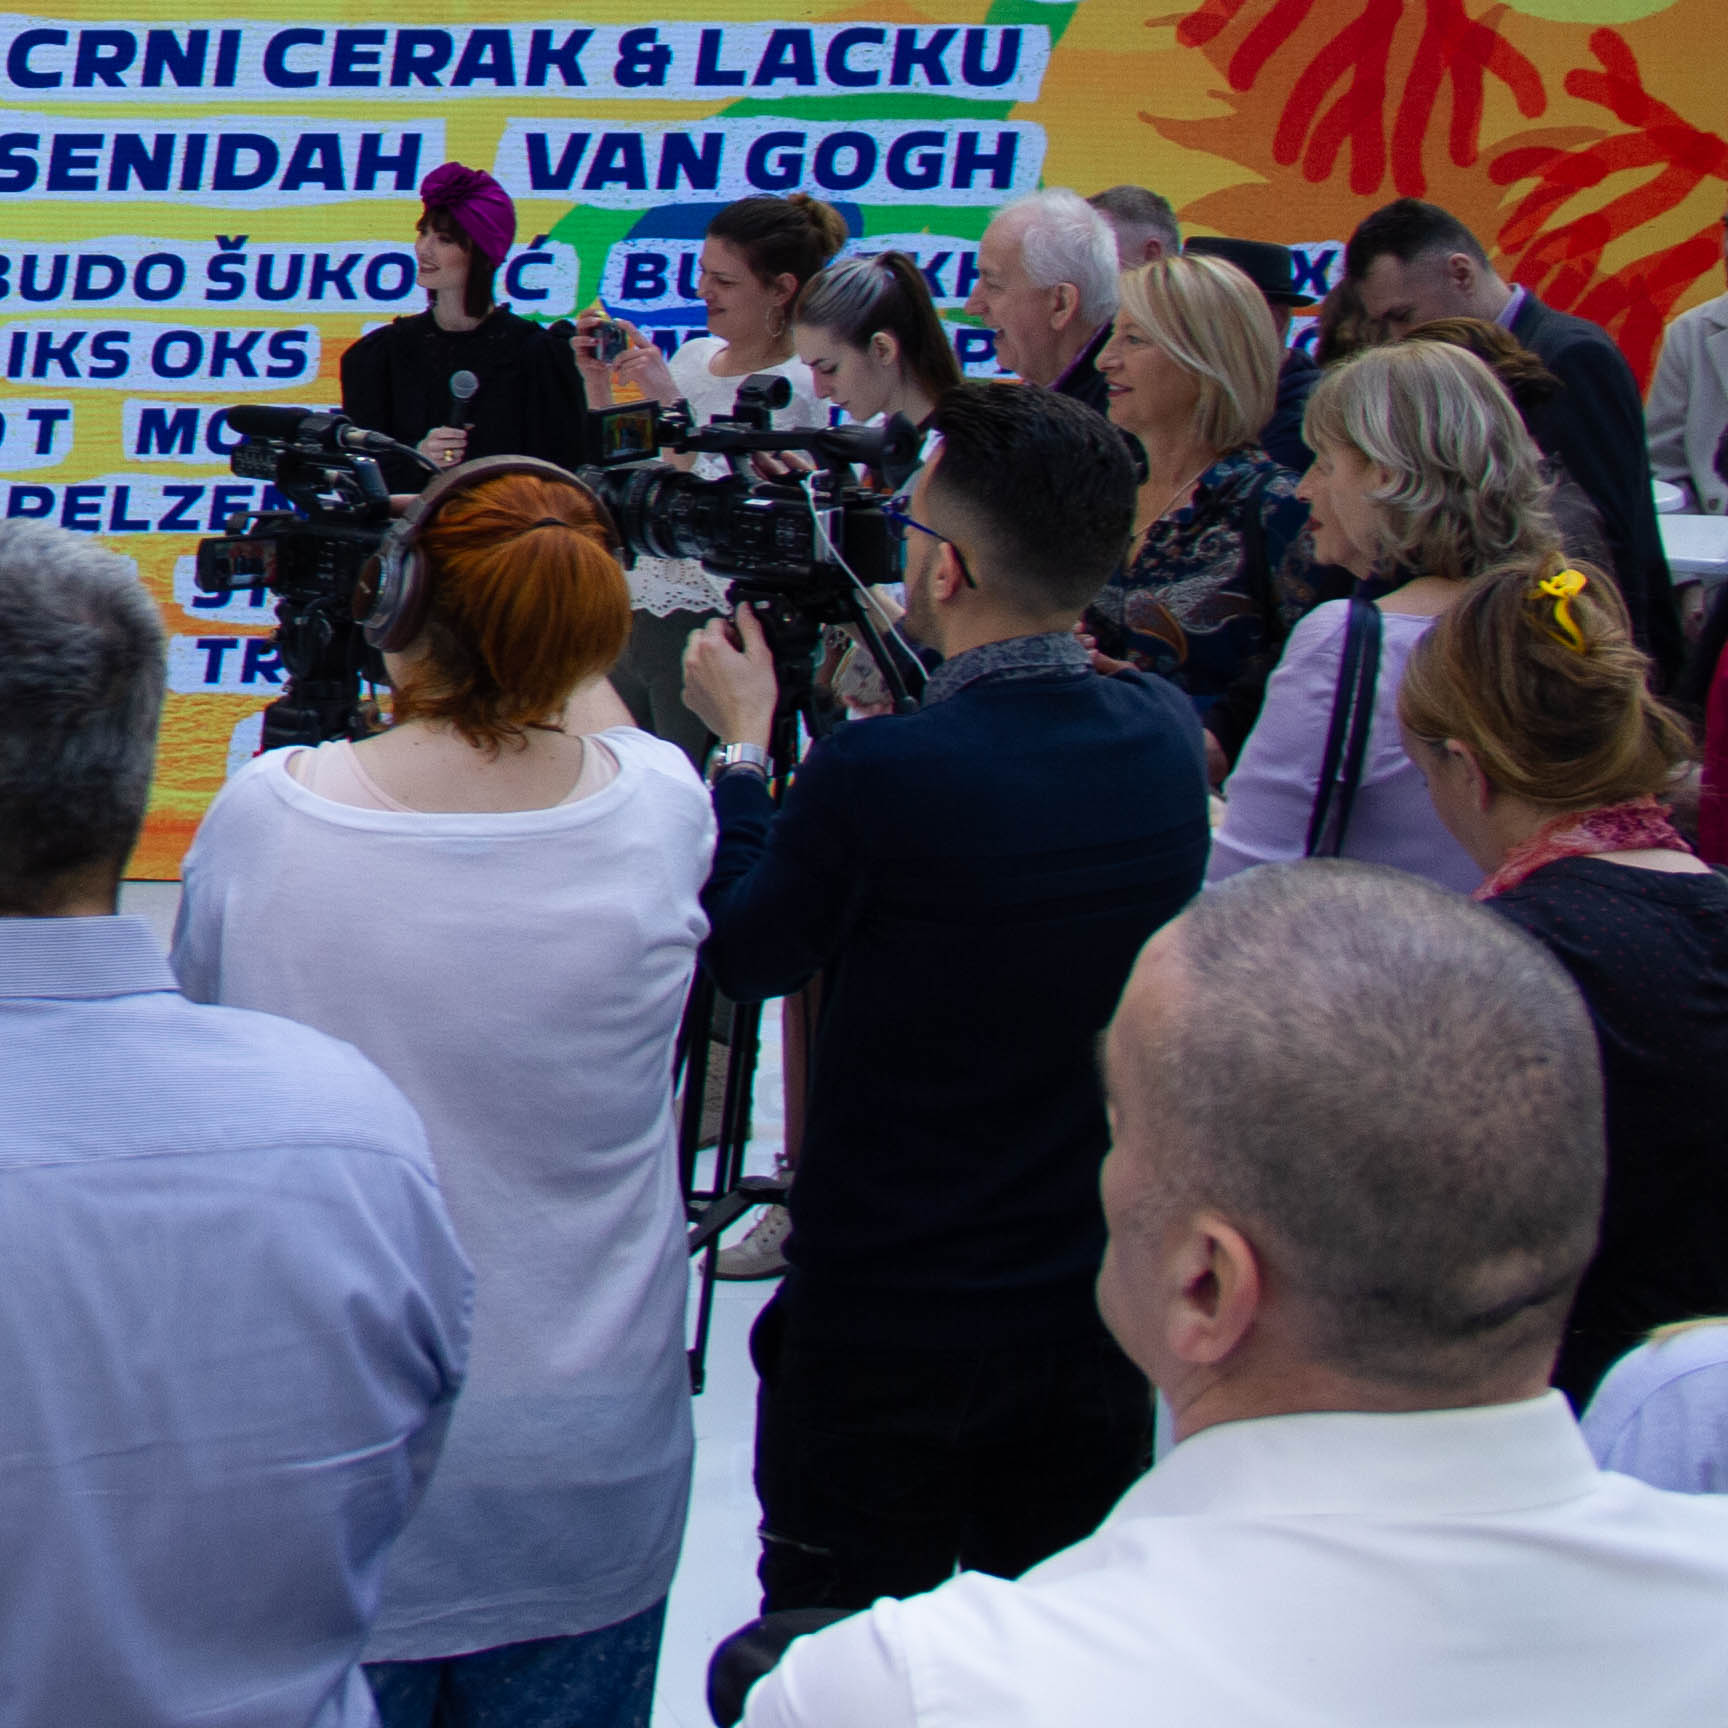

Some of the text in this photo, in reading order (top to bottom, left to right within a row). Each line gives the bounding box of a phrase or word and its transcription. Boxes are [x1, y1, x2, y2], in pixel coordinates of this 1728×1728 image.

[6, 27, 1023, 89] CRNI CERAK & LACKU
[525, 132, 725, 191] VAN
[745, 130, 1019, 192] GOGH
[204, 234, 555, 301] ŠUKOĆ
[6, 329, 309, 379] IKS OKS
